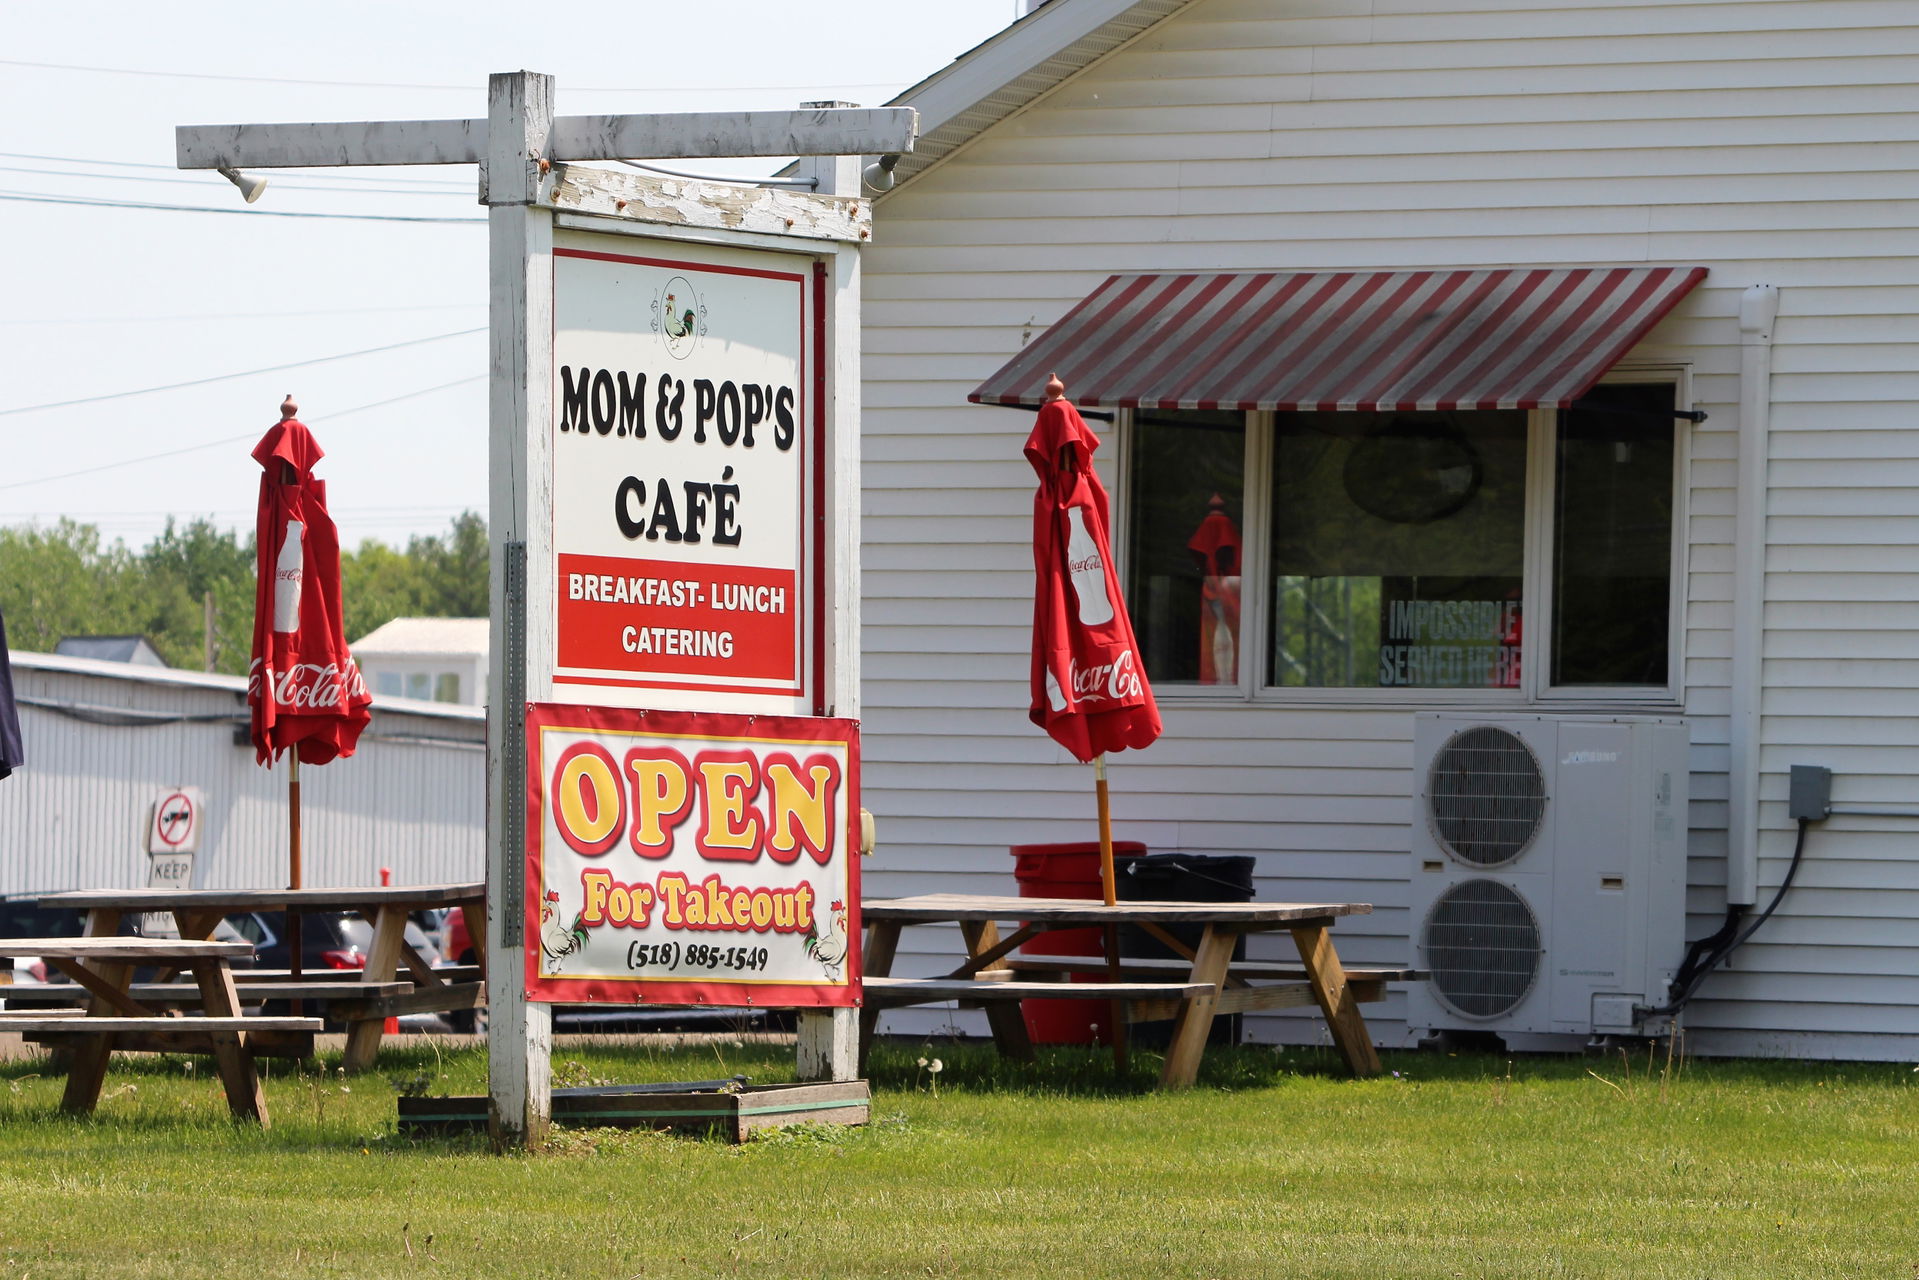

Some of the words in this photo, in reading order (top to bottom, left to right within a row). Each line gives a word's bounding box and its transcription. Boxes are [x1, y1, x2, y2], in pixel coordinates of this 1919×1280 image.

[560, 365, 647, 438] MOM
[655, 373, 685, 441] &
[694, 379, 794, 451] POP'S
[615, 465, 742, 546] CAFÉ
[711, 583, 785, 614] LUNCH
[1389, 600, 1518, 640] IMPOSSIBLE
[622, 625, 733, 658] CATERING
[1380, 646, 1463, 685] SERVED
[1468, 646, 1521, 685] HERE
[555, 746, 837, 860] OPEN
[154, 863, 188, 880] KEEP
[582, 870, 654, 926] For
[658, 873, 814, 930] Takeout
[627, 940, 681, 971] (518)
[685, 944, 769, 971] 885-1549
